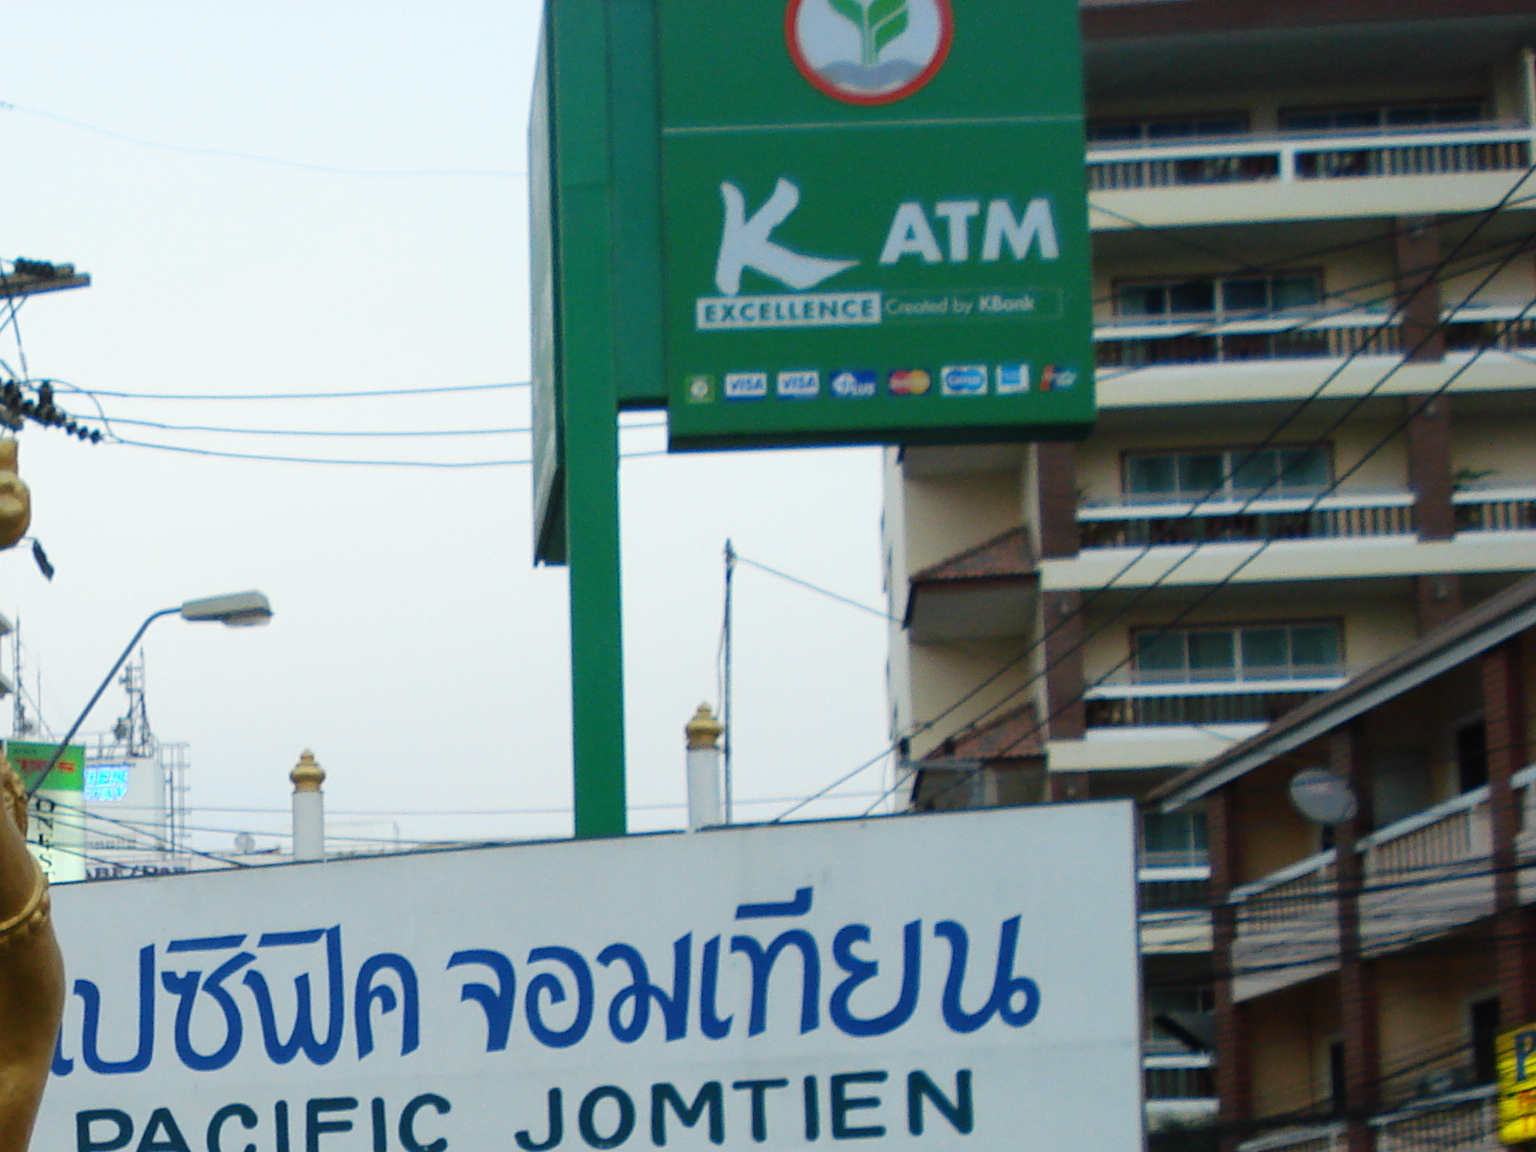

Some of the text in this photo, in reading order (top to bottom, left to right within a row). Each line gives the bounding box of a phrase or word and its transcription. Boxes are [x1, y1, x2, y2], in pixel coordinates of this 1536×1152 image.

[716, 177, 1060, 296] K ATM
[704, 294, 1035, 323] EXCELLENCE Created by KBank
[731, 377, 763, 391] VISA
[783, 376, 815, 390] VISA
[446, 886, 1042, 1053] จอมเทียน
